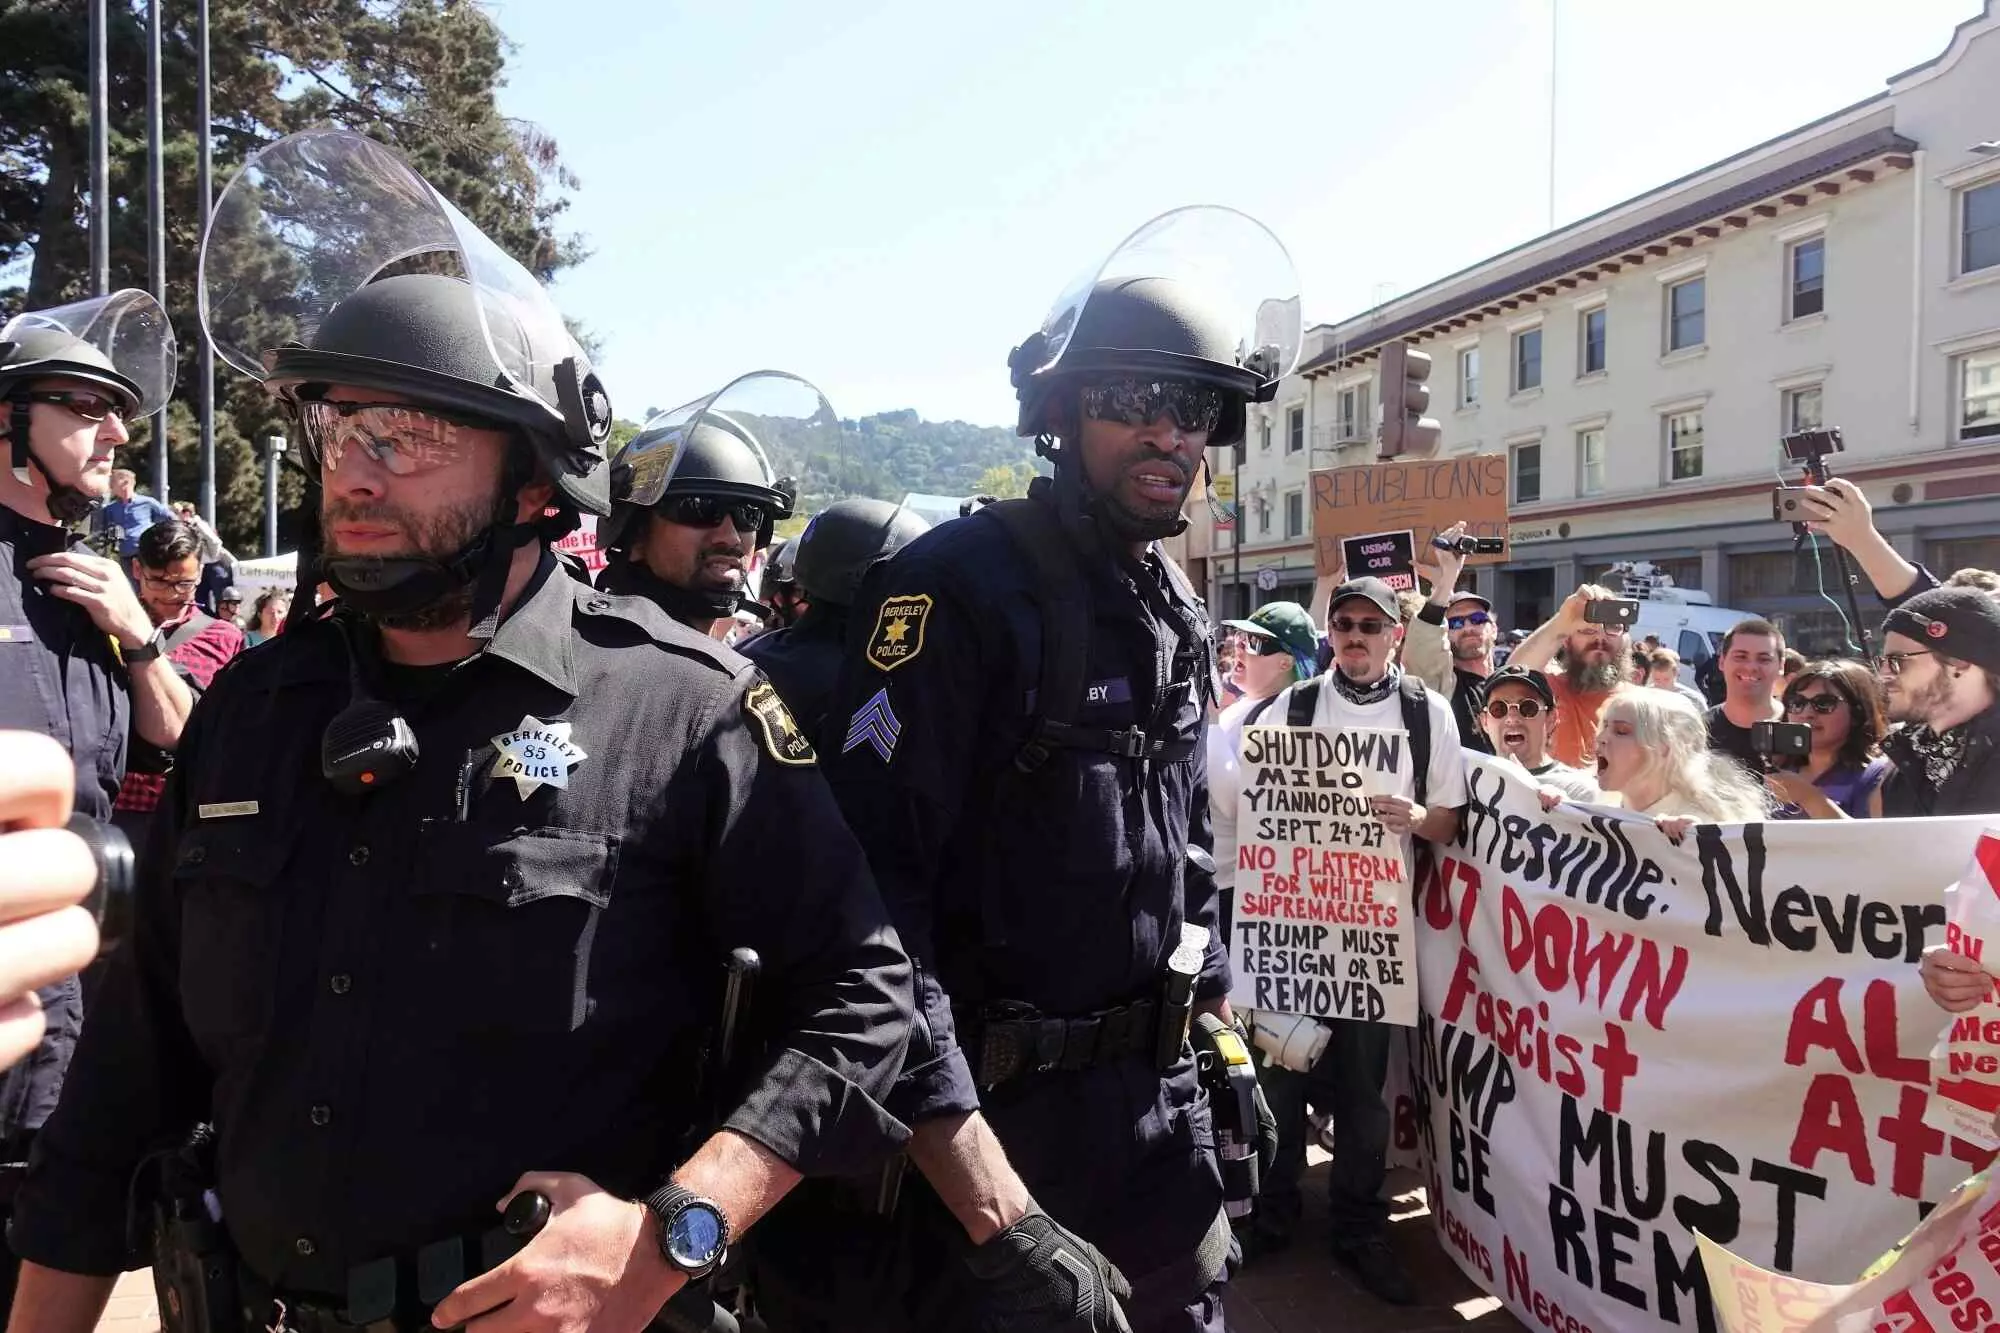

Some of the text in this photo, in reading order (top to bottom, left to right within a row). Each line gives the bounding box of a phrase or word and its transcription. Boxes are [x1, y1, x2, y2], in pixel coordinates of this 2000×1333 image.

[1313, 457, 1505, 511] REPUBLICANS
[1360, 540, 1396, 555] USING
[1368, 557, 1392, 569] OUR
[1378, 573, 1413, 590] PEECH
[884, 604, 926, 617] BERKELEY
[876, 644, 908, 657] POLICE
[1087, 685, 1108, 701] BY
[502, 730, 576, 757] BERKELEY
[523, 745, 546, 760] 85
[1244, 730, 1399, 773] SHUTDOWN
[503, 759, 559, 777] POLICE
[1256, 768, 1362, 789] MILO
[1256, 817, 1322, 845] SEPT.
[1239, 845, 1400, 883] NO PLATFORM
[1263, 872, 1374, 904] FOR WHITE
[1698, 823, 1946, 963] Never
[1240, 893, 1398, 928] SUPREMACISTS
[1237, 921, 1399, 957] TRUMP MUST
[1244, 951, 1404, 985] RESIGN OR BE
[1501, 885, 1688, 1031] DOWN
[1256, 976, 1385, 1022] REMOVED
[1441, 946, 1638, 1114] Fascist
[1412, 1003, 1516, 1138] RUMP
[1559, 1094, 1828, 1272] MUST
[1450, 1108, 1497, 1219] BE
